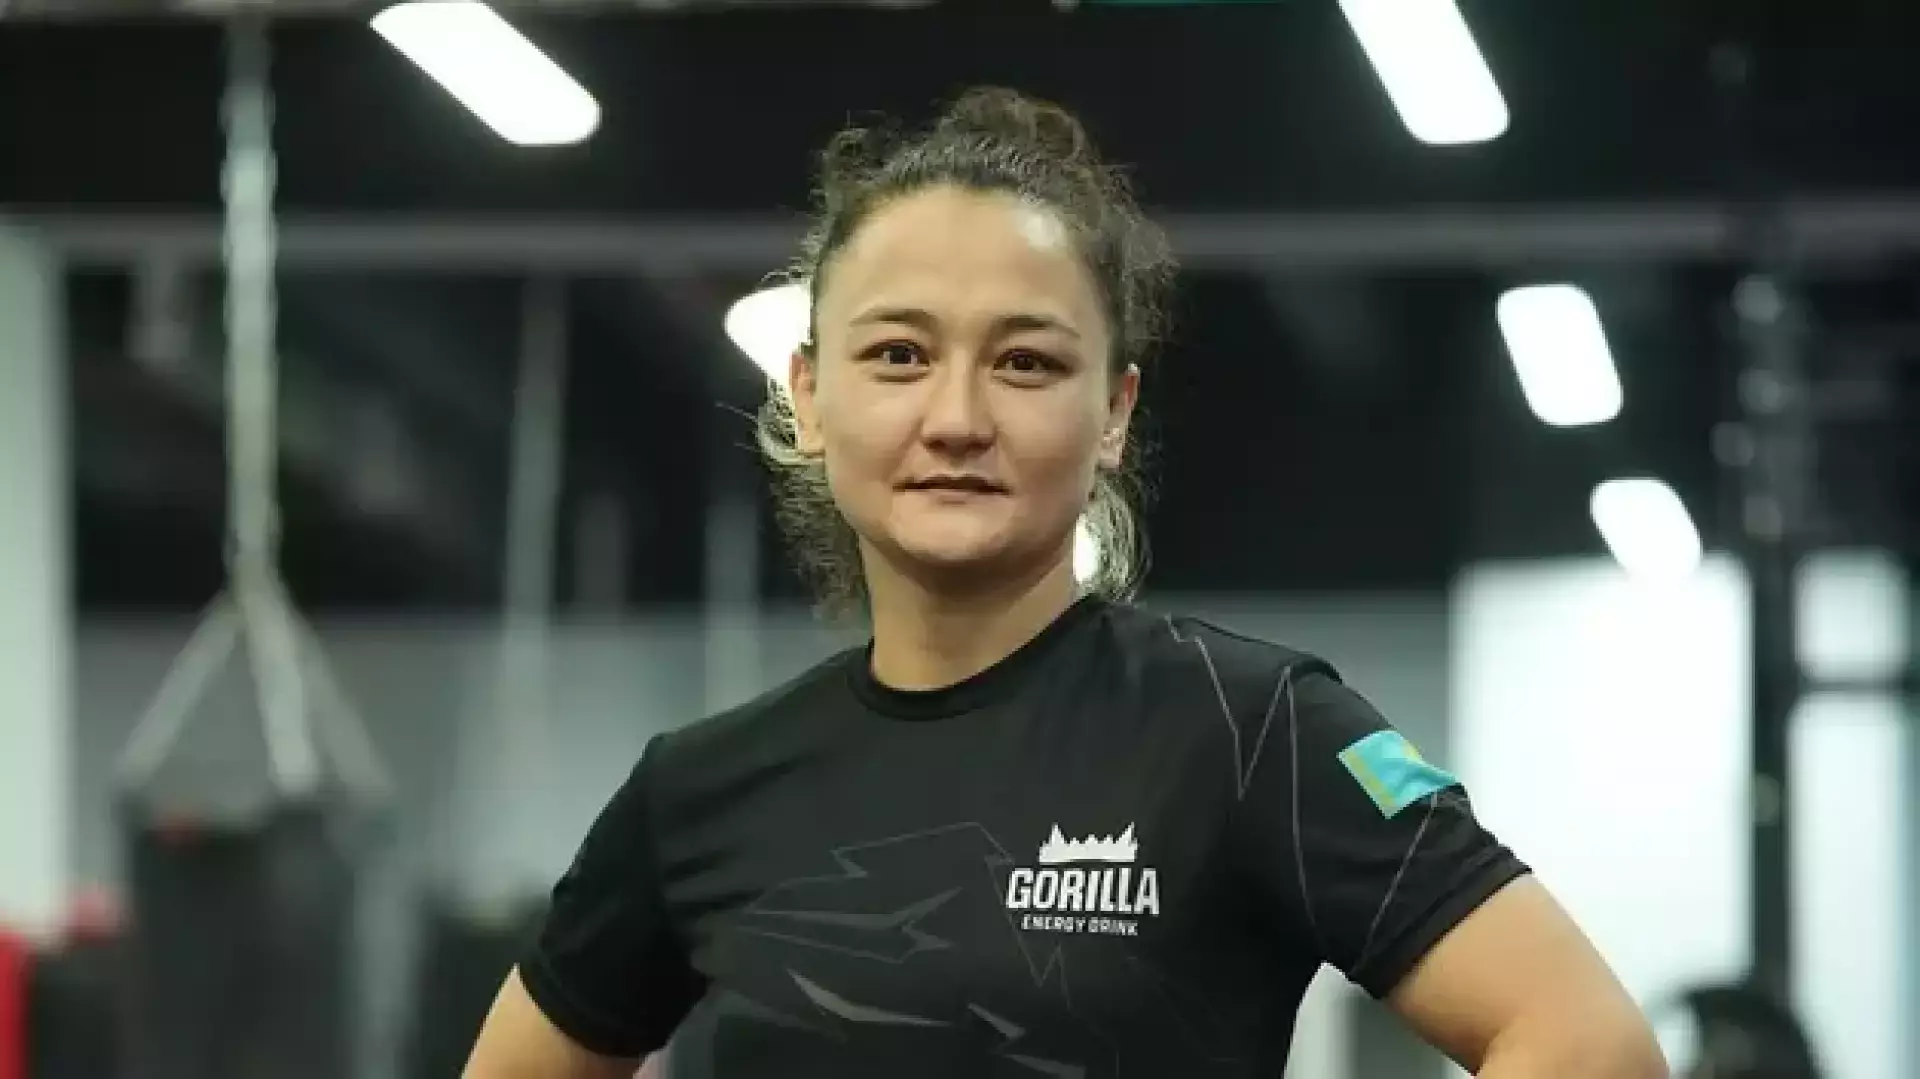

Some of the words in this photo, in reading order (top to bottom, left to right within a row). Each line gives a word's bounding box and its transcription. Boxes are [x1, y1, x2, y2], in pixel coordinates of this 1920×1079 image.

[1006, 867, 1160, 916] GORILLA
[1021, 914, 1086, 933] ENERGY
[1087, 917, 1139, 936] DRINK
